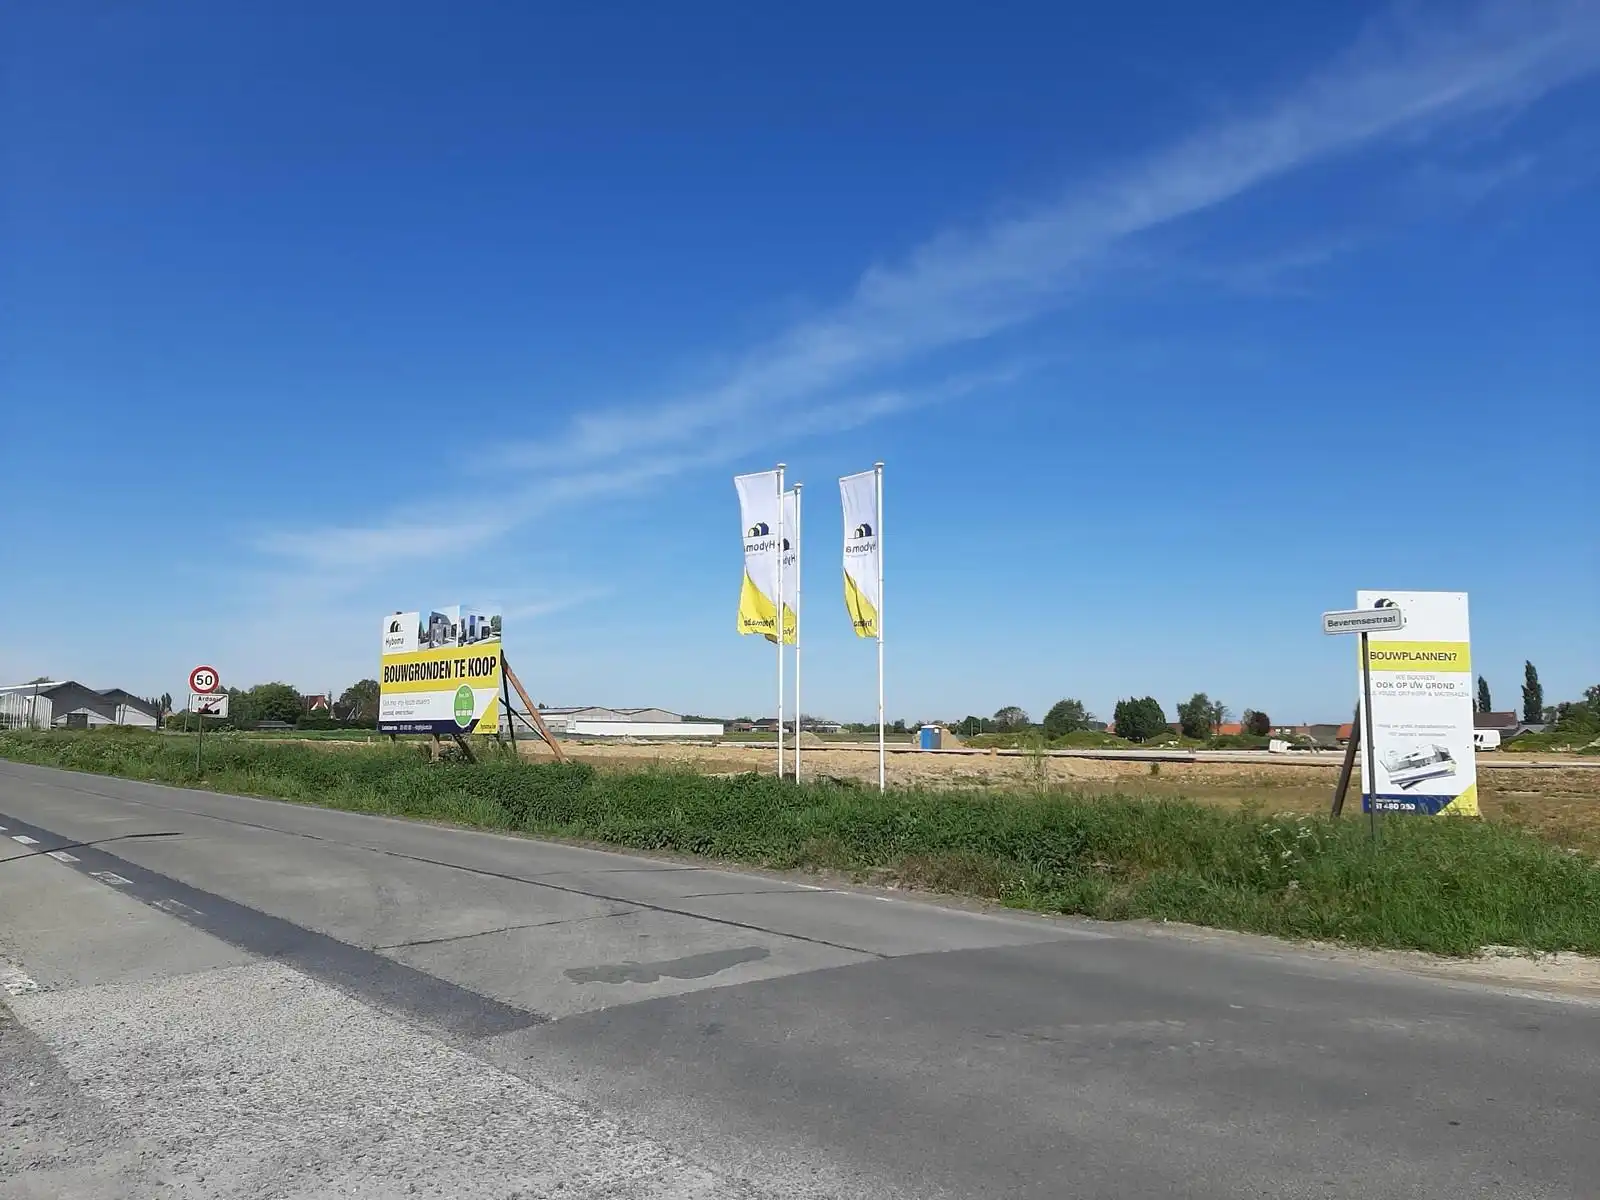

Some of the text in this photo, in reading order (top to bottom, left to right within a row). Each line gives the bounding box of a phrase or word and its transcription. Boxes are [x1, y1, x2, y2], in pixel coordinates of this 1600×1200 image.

[1327, 615, 1396, 628] Beverensestraat
[1370, 651, 1457, 661] BOUWPLANNEN?
[384, 656, 497, 683] BOUWGRONDEN TE KOOP
[196, 675, 213, 685] 50
[1376, 681, 1394, 689] OOK
[1425, 682, 1455, 690] GROND
